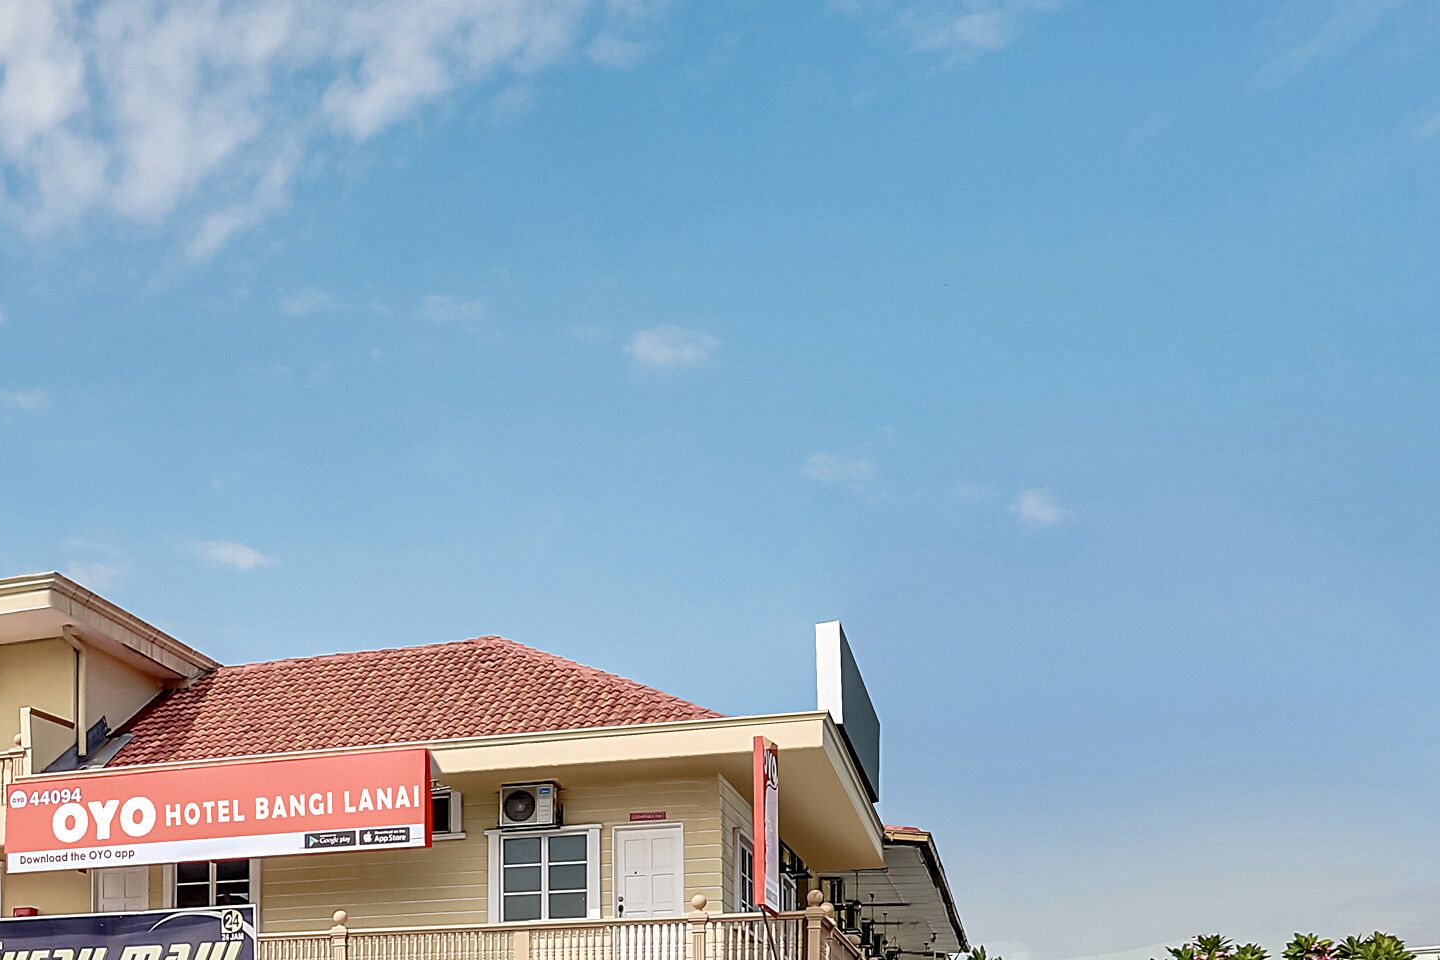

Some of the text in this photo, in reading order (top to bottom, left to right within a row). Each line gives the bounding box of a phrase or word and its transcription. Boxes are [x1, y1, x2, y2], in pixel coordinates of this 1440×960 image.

[29, 787, 82, 806] 44094
[52, 785, 420, 843] OYO HOTEL BANGI LANAI
[319, 836, 339, 845] Google
[339, 835, 351, 843] play
[374, 835, 389, 843] App
[20, 849, 135, 864] Download the OYO app
[225, 914, 240, 928] 24
